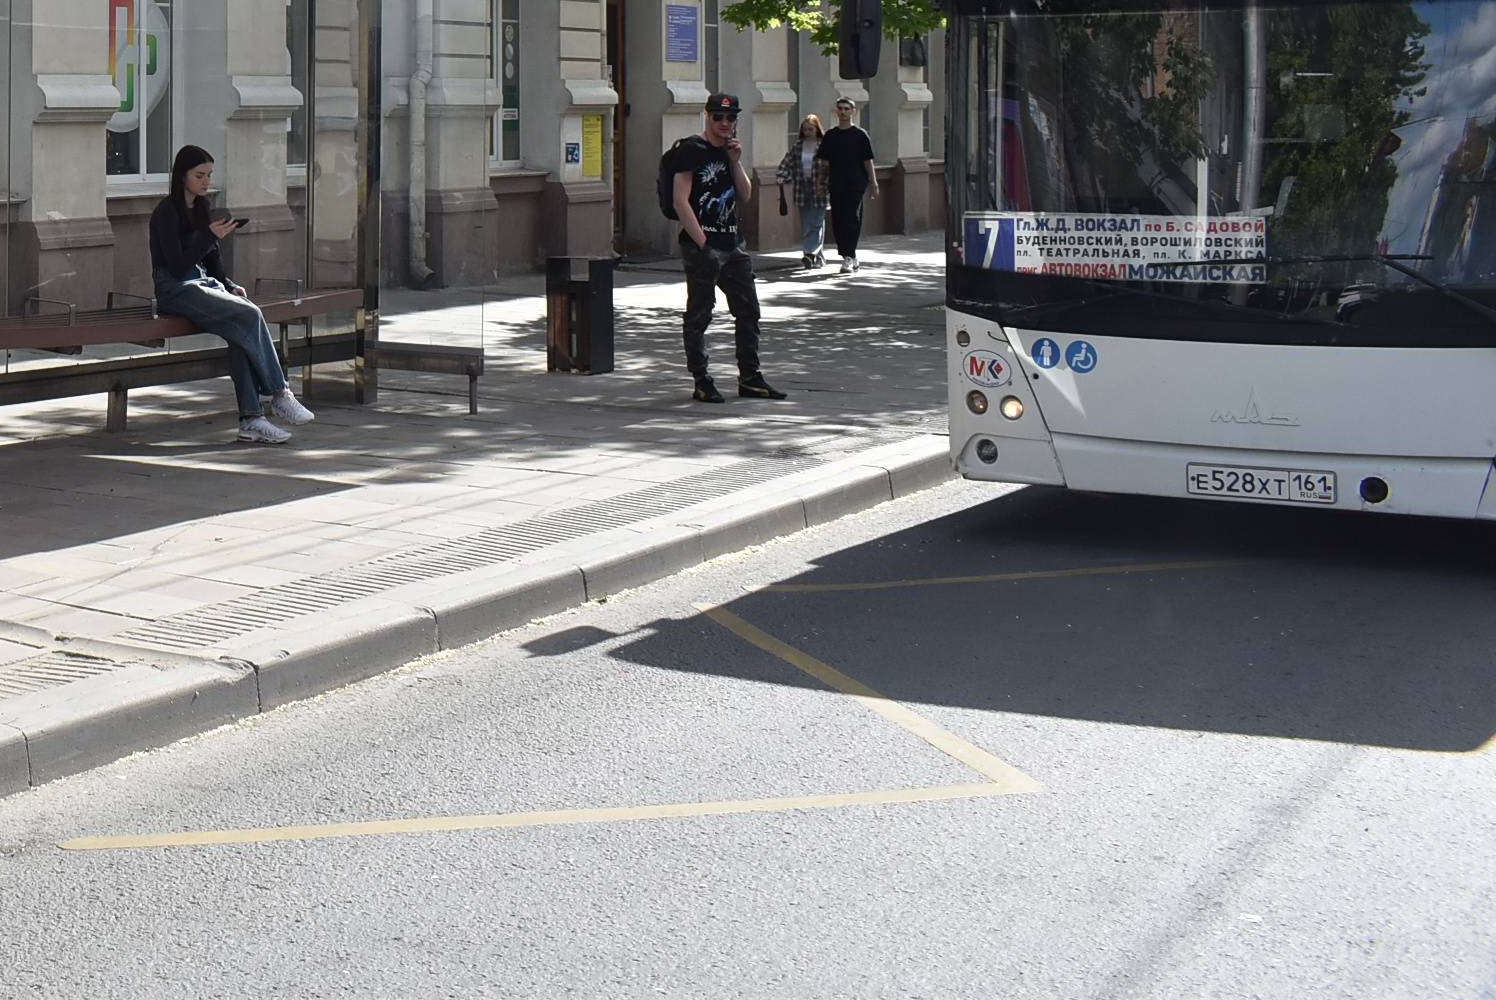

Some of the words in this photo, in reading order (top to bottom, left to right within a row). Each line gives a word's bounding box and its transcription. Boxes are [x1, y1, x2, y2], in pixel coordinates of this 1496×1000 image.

[1075, 217, 1141, 232] ВОКЗАЛ
[1144, 223, 1162, 232] по
[1165, 221, 1180, 232] Б.
[1184, 220, 1264, 234] САДОВОЙ
[978, 220, 1000, 269] 7
[1016, 234, 1128, 248] БУДЕННОВСКИЙ,
[1131, 236, 1265, 248] ВОРОШИЛОВСКИЙ
[1038, 247, 1146, 260] ТЕАТРАЛЬНАЯ,
[1177, 250, 1192, 259] К.
[1200, 250, 1265, 260] МАРКСА
[1041, 263, 1128, 280] АВТОВОКЗАЛ
[1293, 474, 1328, 493] 161
[1300, 491, 1318, 499] RUS
